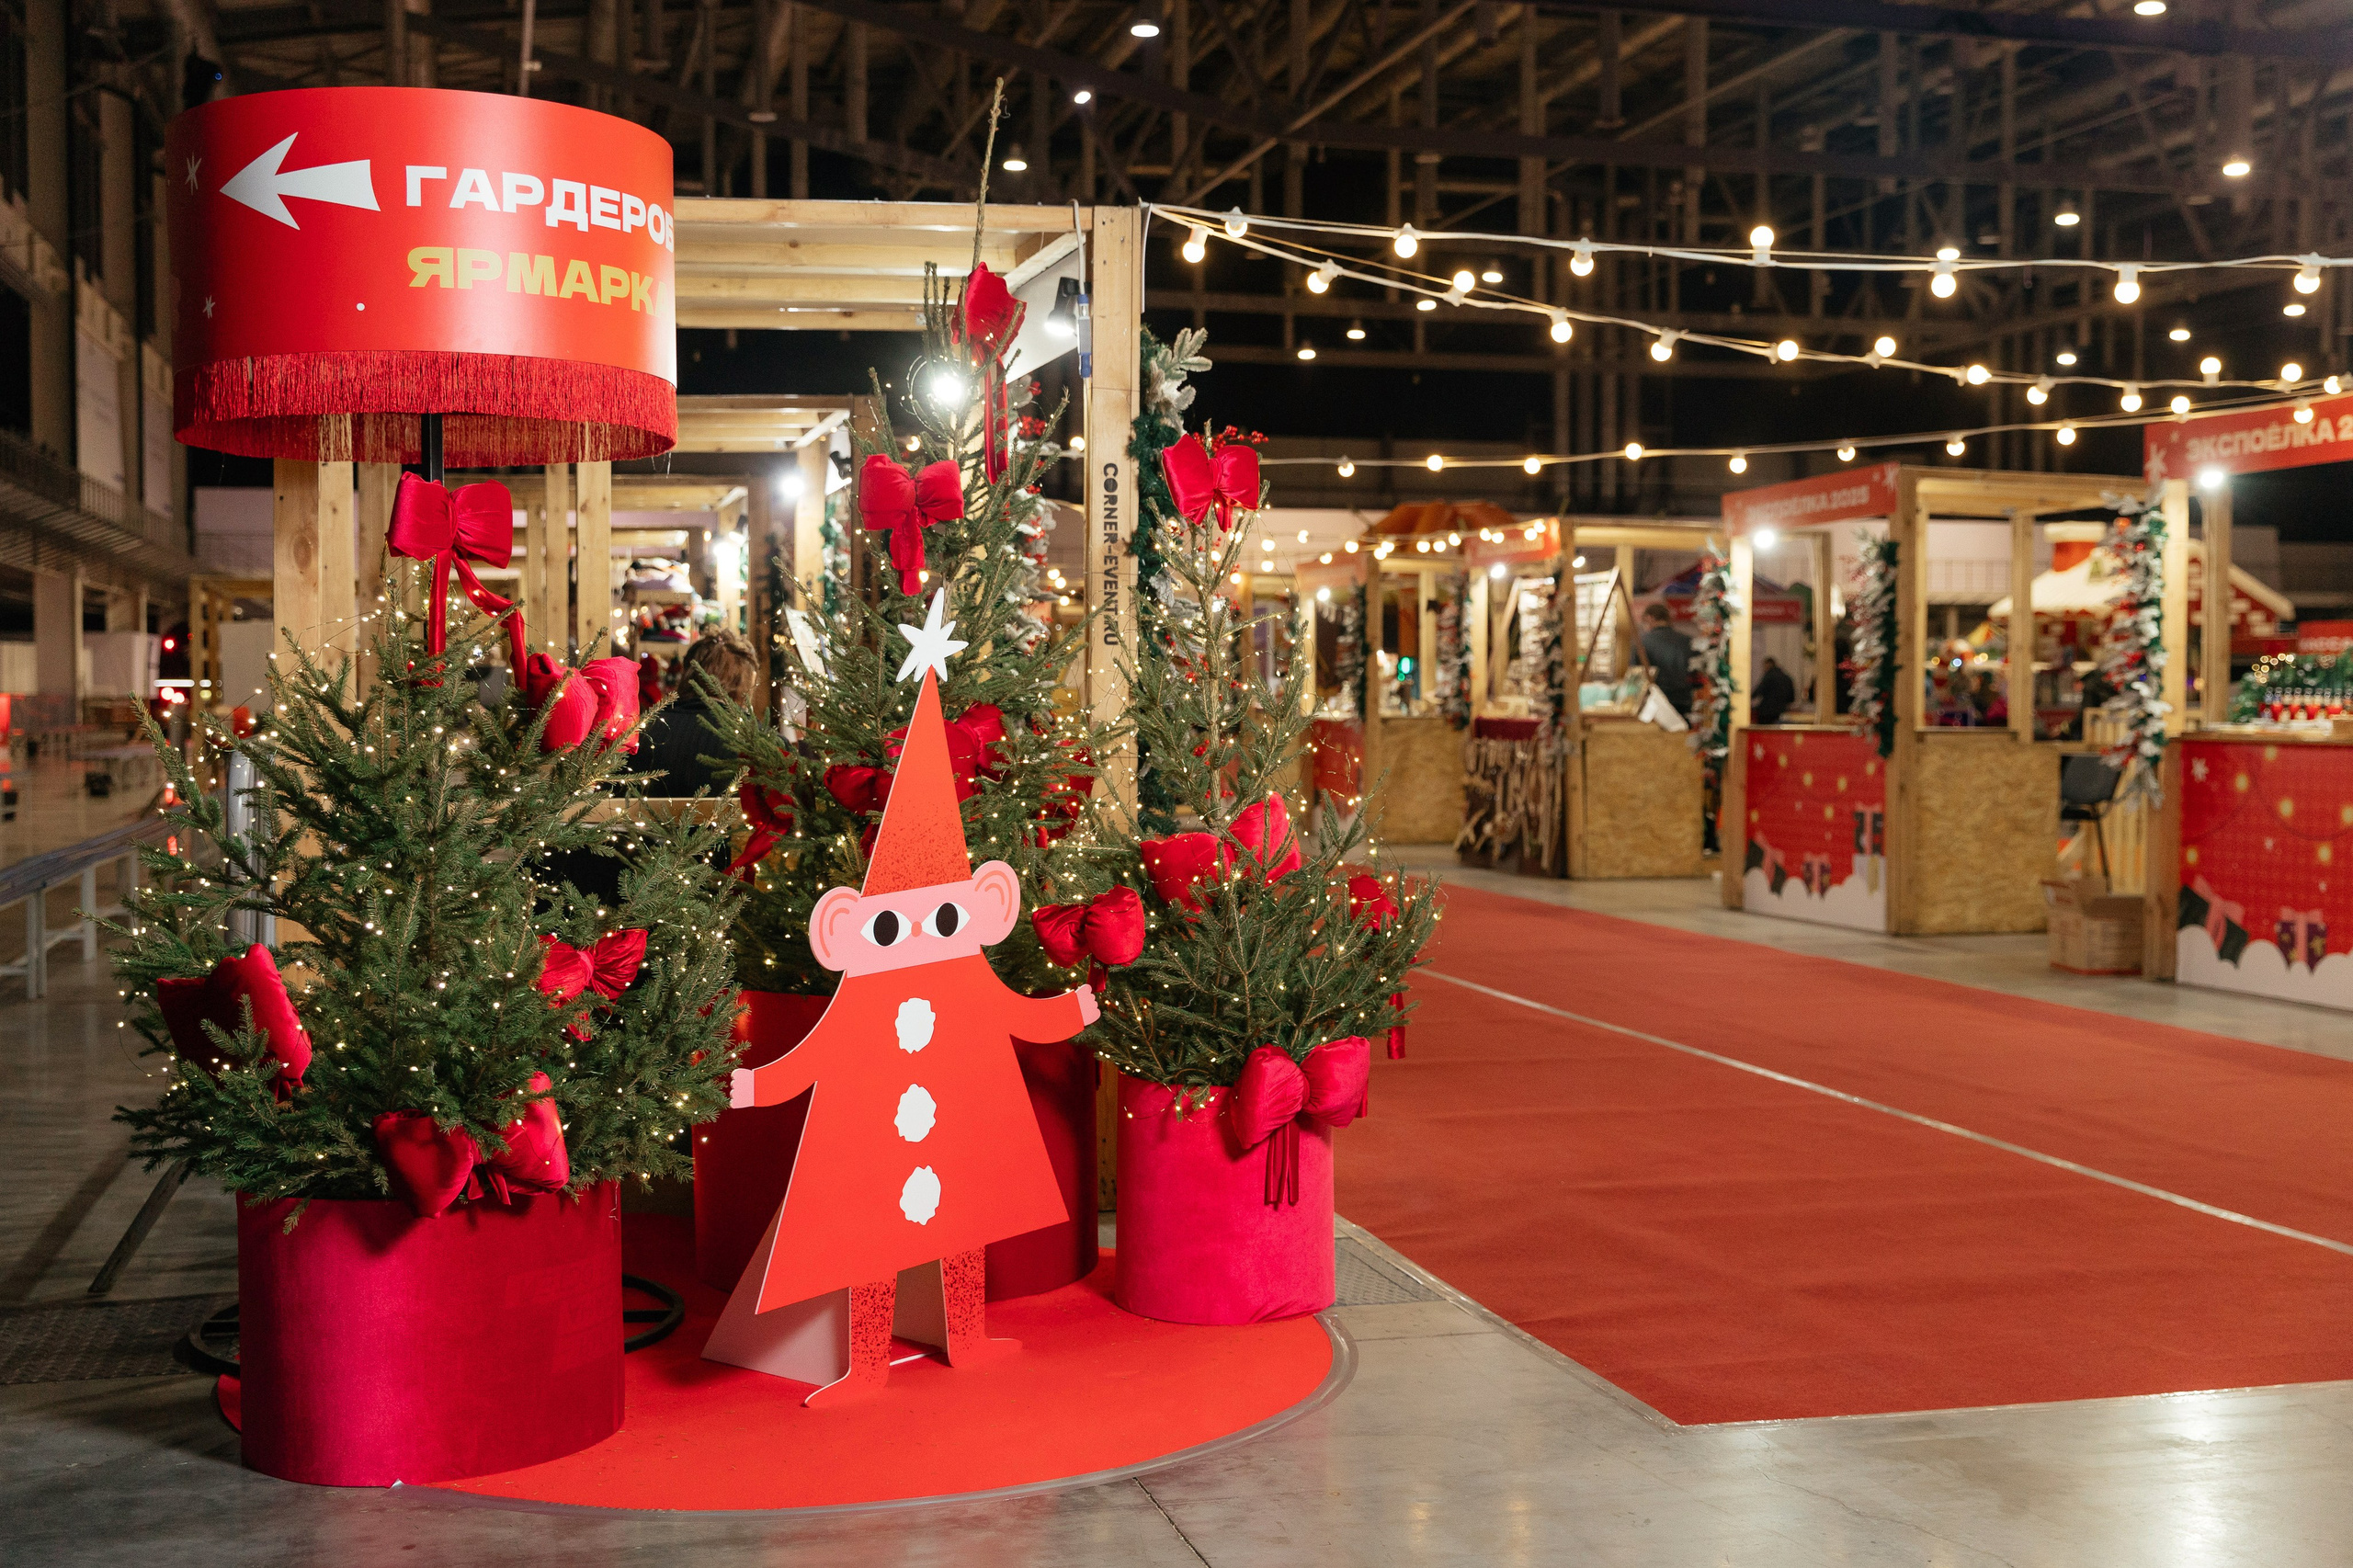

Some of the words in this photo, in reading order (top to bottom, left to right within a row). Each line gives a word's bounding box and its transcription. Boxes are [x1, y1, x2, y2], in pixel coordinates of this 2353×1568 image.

[405, 165, 675, 253] ГАРДЕРОБ
[2185, 416, 2336, 461] ЭКСПОЁЛКА
[1103, 462, 1119, 646] CORNER-EVENTRU
